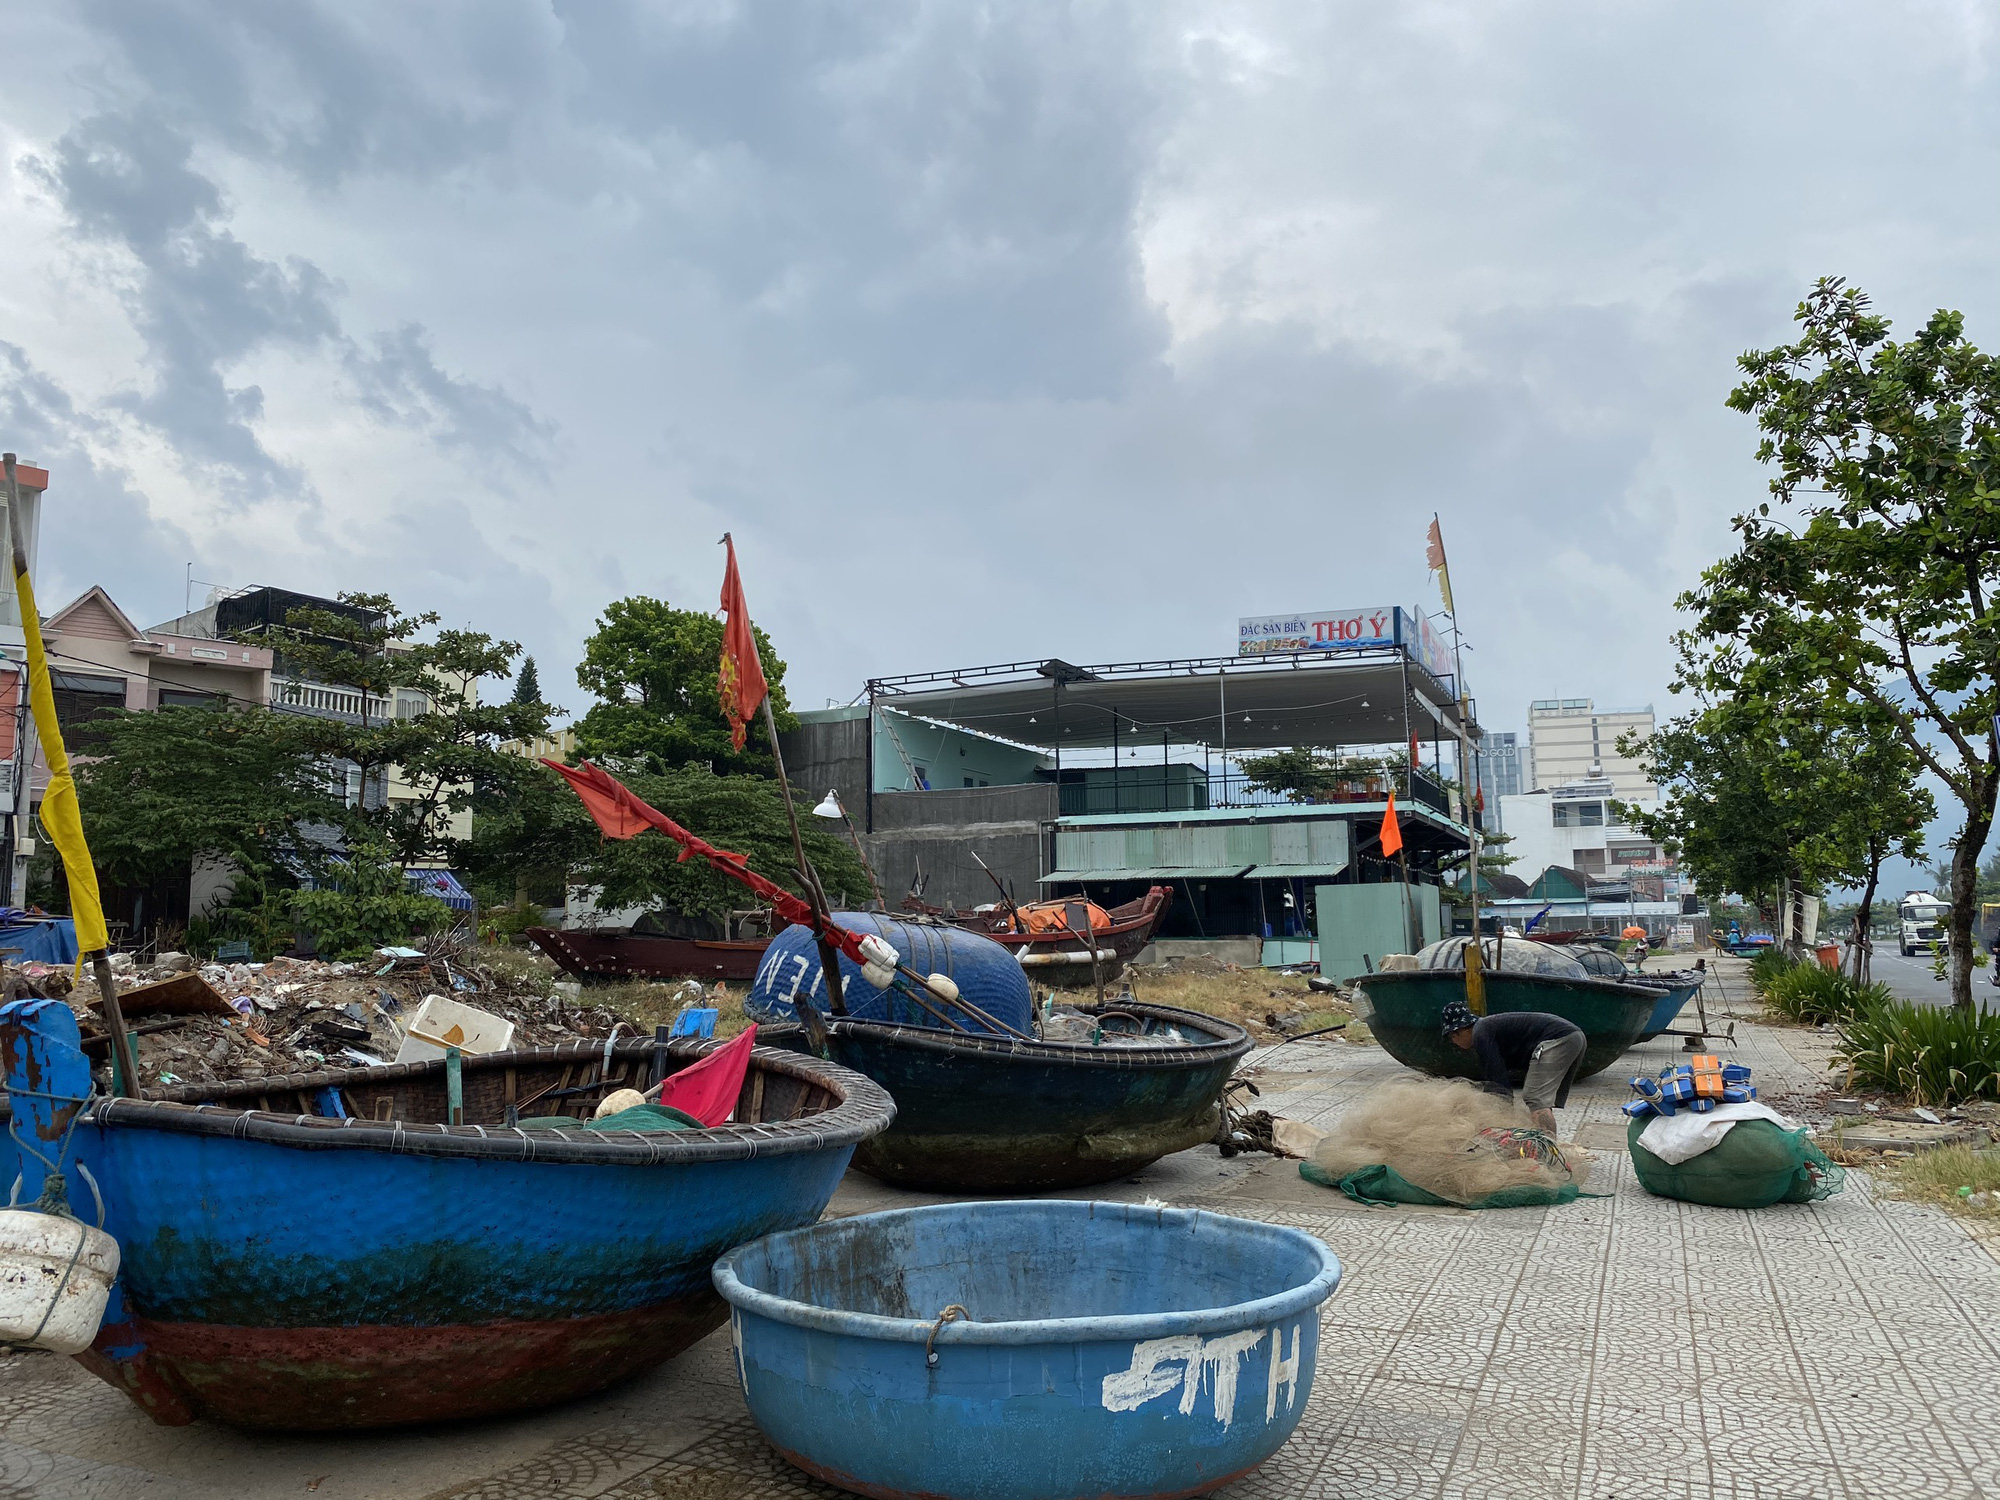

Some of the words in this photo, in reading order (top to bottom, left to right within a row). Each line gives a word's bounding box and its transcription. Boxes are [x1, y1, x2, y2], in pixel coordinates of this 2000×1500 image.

[1312, 615, 1363, 641] THƠ
[1369, 610, 1387, 637] Ý
[1456, 748, 1488, 758] GAD
[1489, 748, 1515, 757] GOLD
